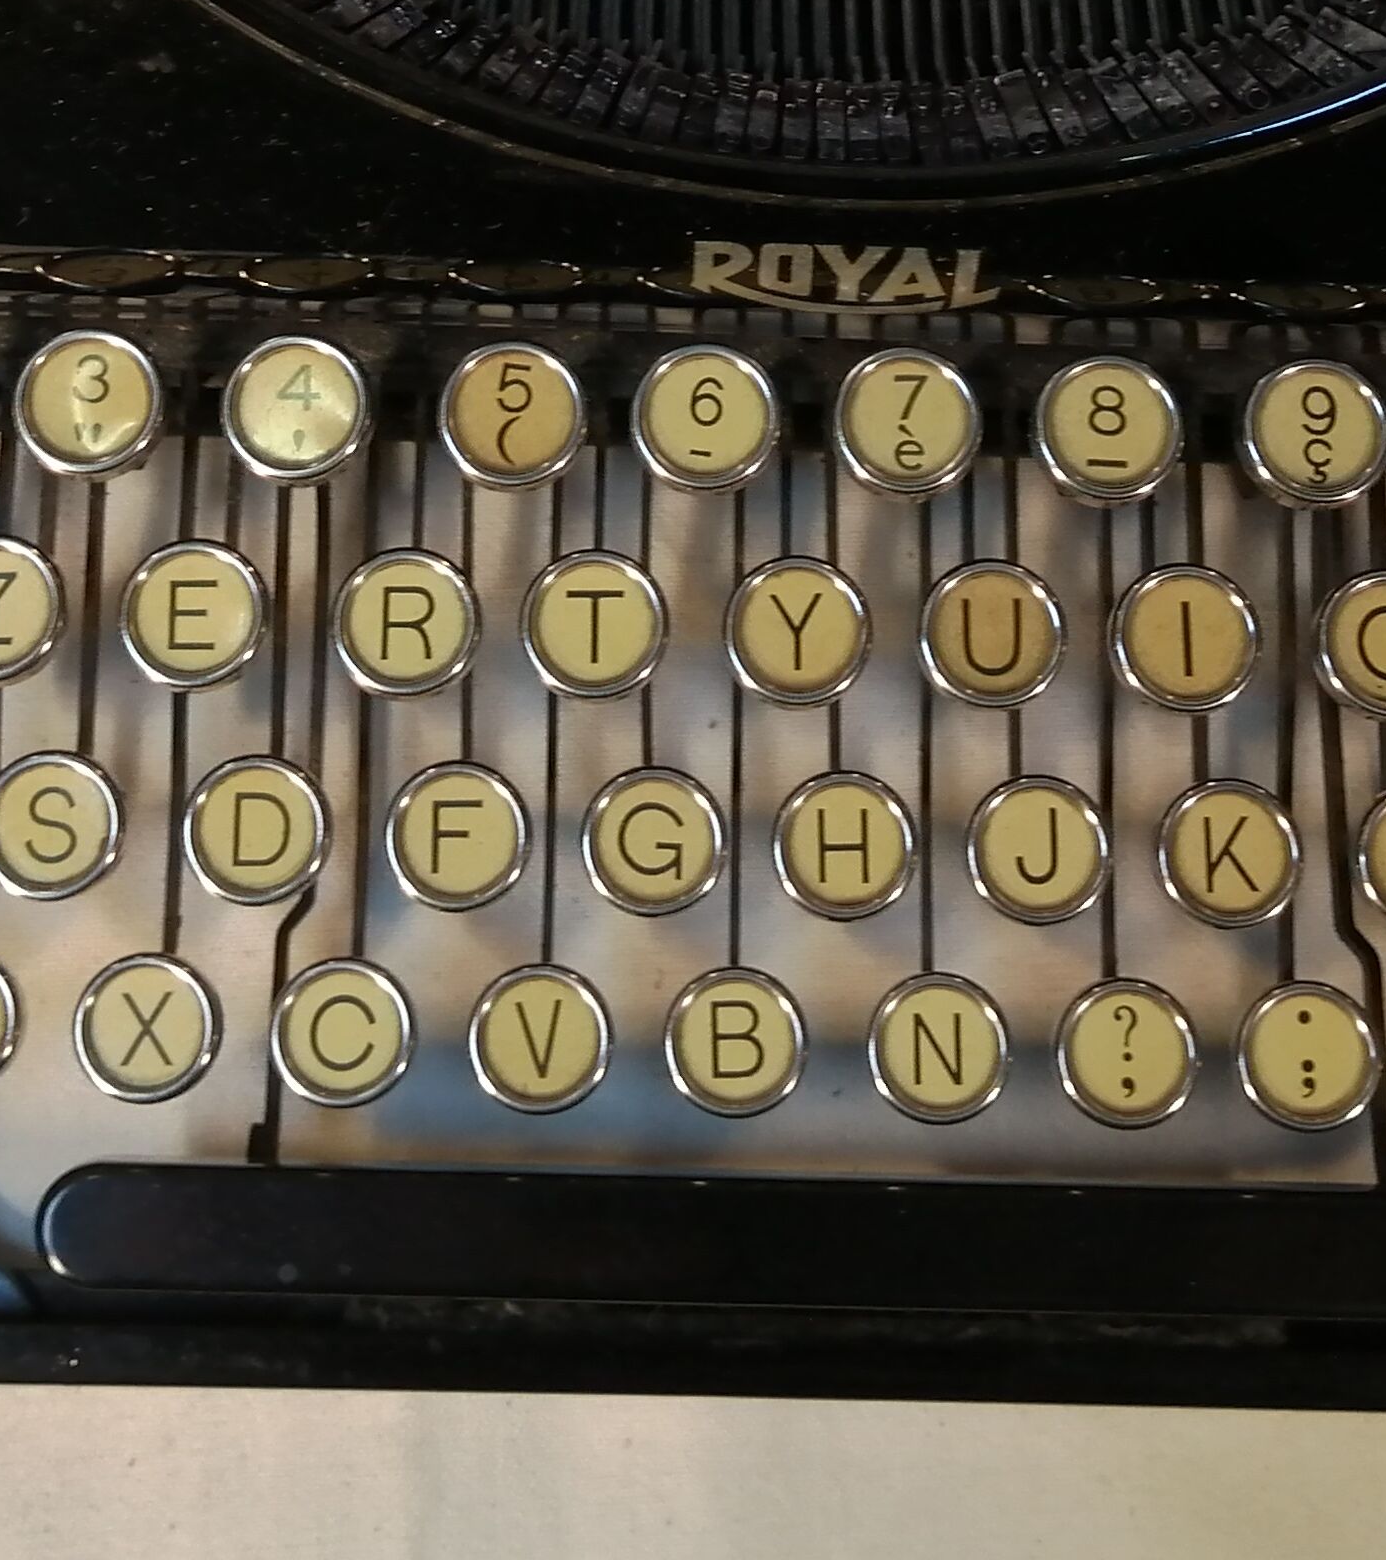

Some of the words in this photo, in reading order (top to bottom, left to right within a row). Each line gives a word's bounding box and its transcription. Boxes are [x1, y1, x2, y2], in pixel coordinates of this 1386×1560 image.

[691, 240, 1001, 315] ROYAL
[77, 354, 111, 404] 3
[276, 364, 321, 411] 4
[496, 362, 532, 413] 5
[690, 376, 724, 427] 6
[893, 374, 929, 421] 7
[1088, 385, 1127, 437] 8
[1301, 386, 1336, 436] 9
[896, 425, 923, 469] è
[1304, 440, 1332, 483] ç
[167, 579, 218, 651] E
[380, 586, 435, 661] R
[566, 590, 625, 664] T
[769, 592, 822, 671] Y
[962, 599, 1020, 676] U
[1180, 601, 1194, 677] I
[25, 786, 77, 864] S
[232, 792, 291, 867] D
[431, 799, 483, 874] F
[619, 802, 684, 880] G
[817, 808, 870, 884] H
[1015, 807, 1058, 885] J
[1203, 816, 1260, 894] K
[120, 991, 173, 1067] X
[309, 994, 376, 1072] C
[515, 999, 562, 1079] V
[710, 1000, 765, 1079] B
[913, 1012, 963, 1086] N
